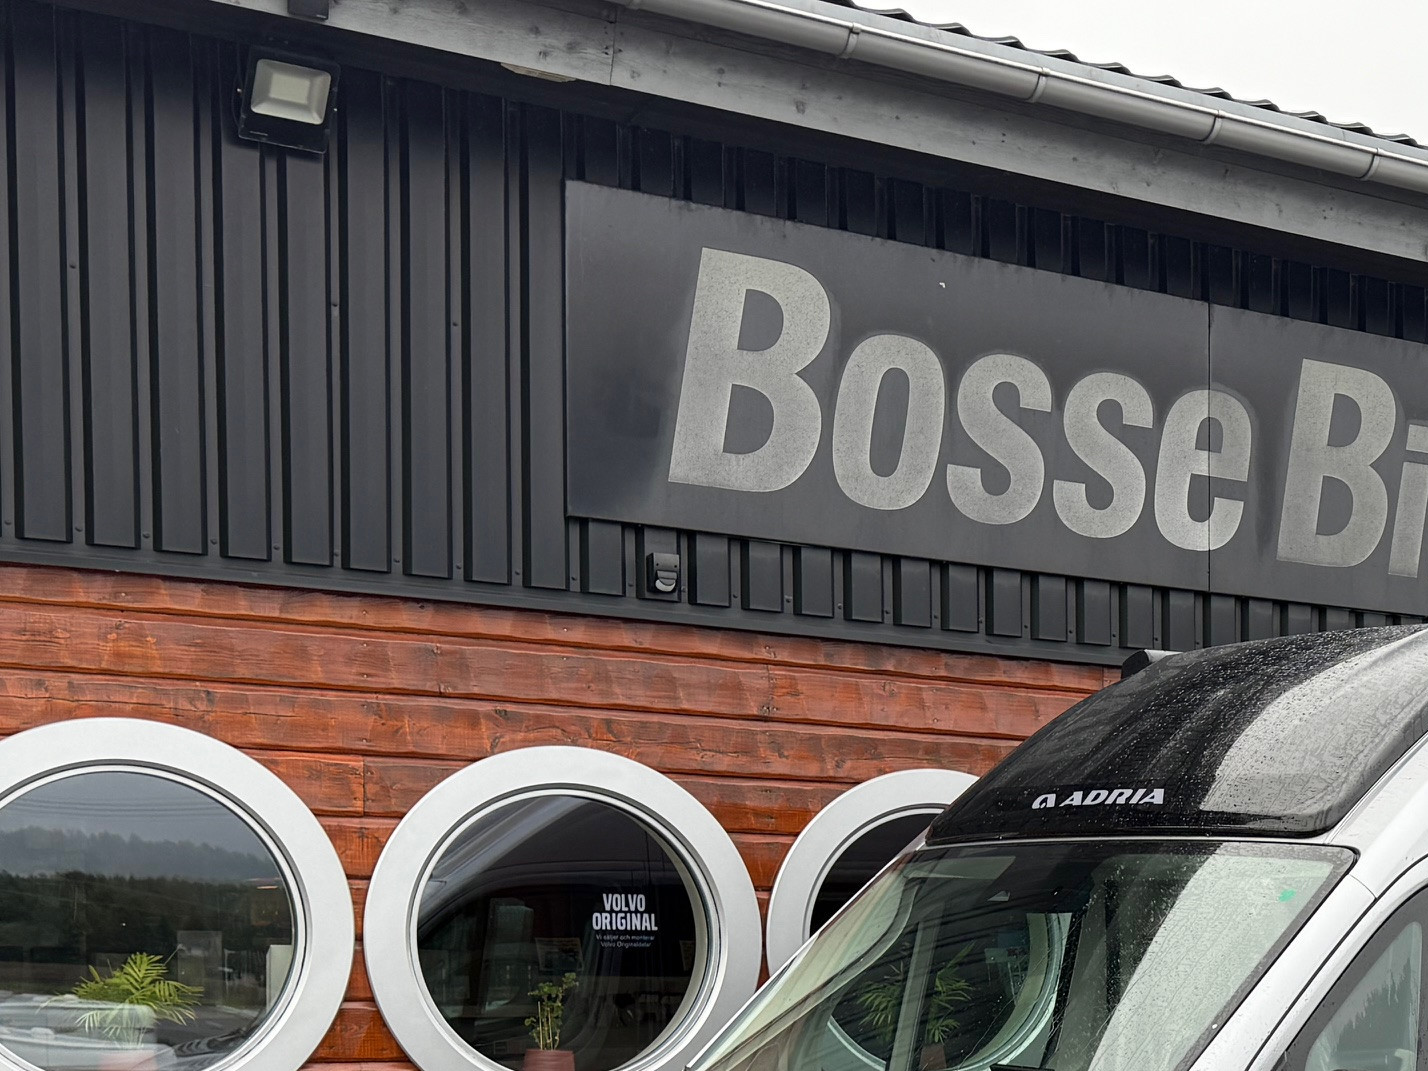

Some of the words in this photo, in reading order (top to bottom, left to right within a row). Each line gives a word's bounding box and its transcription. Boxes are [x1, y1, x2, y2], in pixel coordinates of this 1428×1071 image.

[667, 246, 1250, 551] Bosse
[1059, 788, 1165, 807] ADRIA
[602, 893, 646, 912] VOLVO
[592, 912, 658, 931] ORIGINAL
